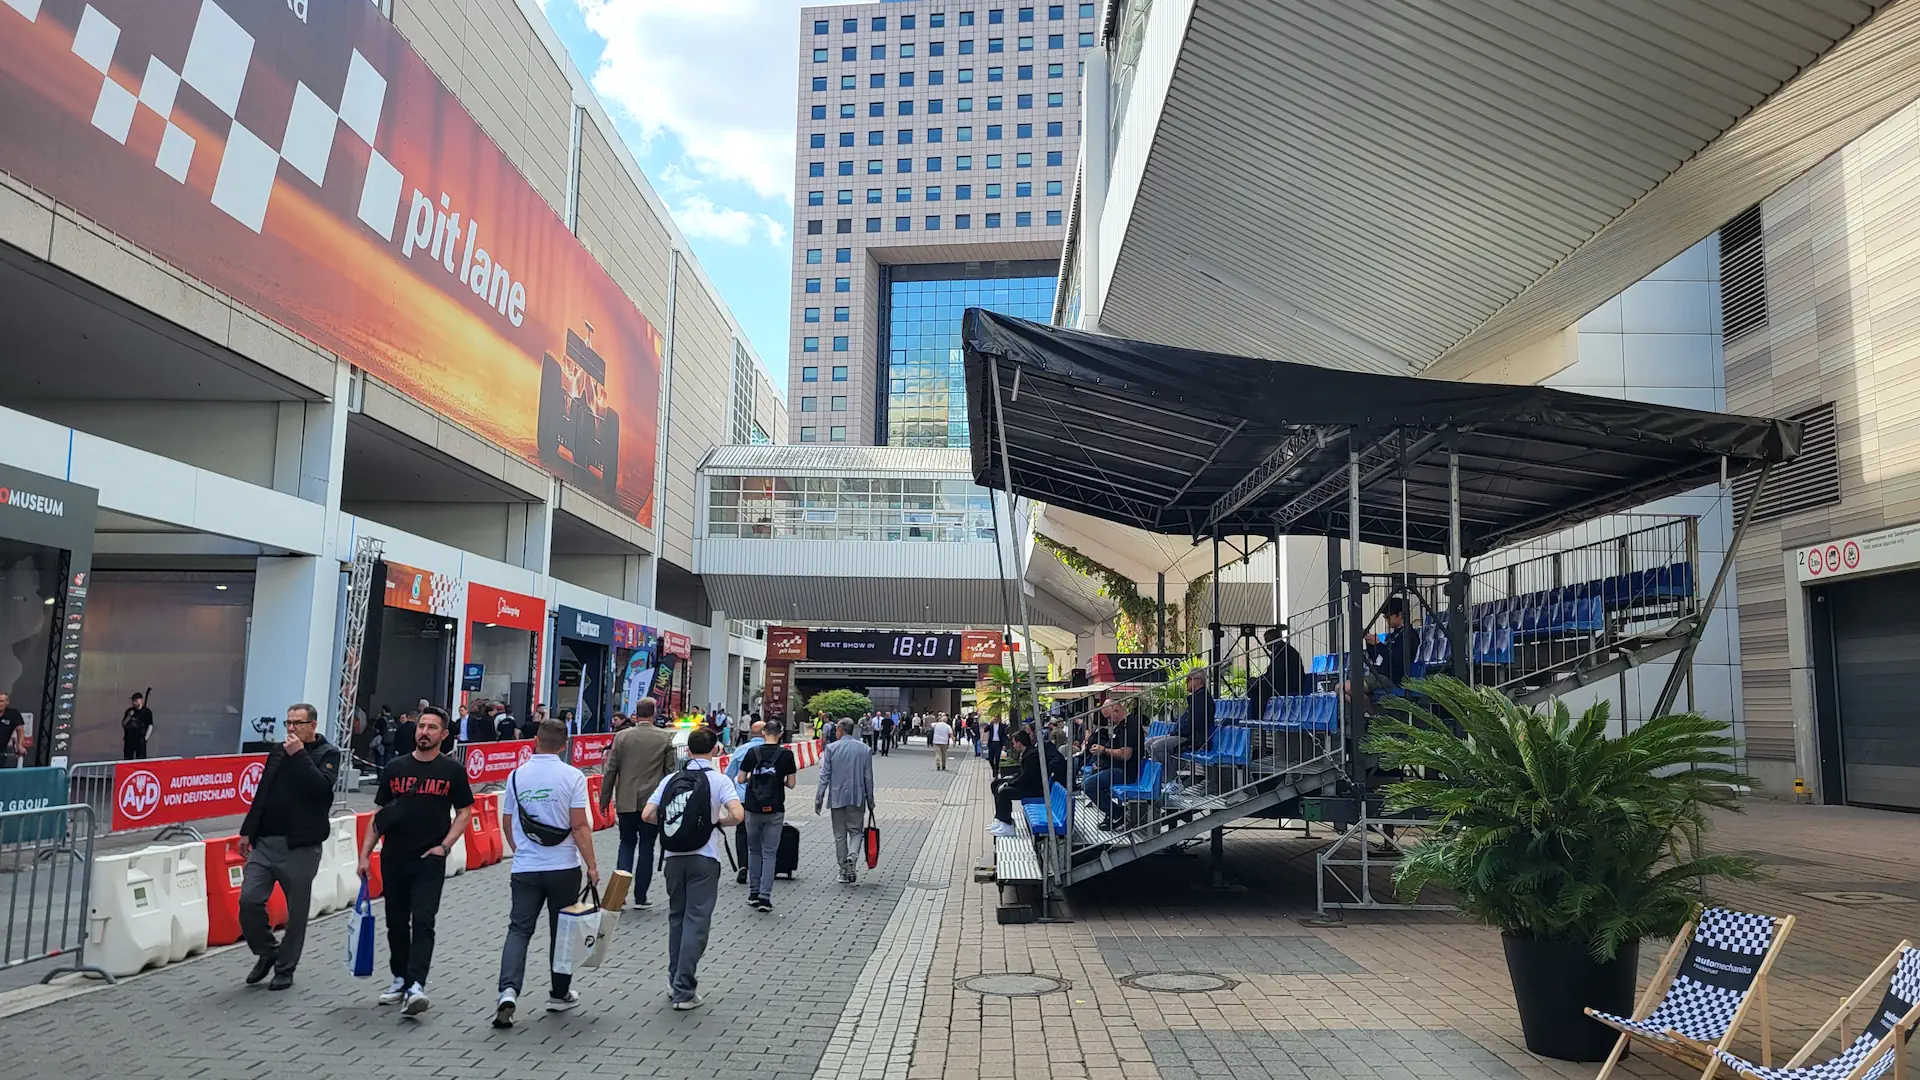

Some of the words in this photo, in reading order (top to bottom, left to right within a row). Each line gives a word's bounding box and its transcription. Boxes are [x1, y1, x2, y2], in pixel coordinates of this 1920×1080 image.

[401, 187, 461, 274] pit
[459, 218, 526, 328] lane
[1798, 551, 1805, 565] 2
[892, 636, 954, 657] 18:01
[1117, 657, 1160, 670] CHIPS
[170, 772, 233, 788] AUTOMOBILCLUB
[9, 798, 49, 812] GROUP
[163, 793, 181, 806] VON
[182, 788, 236, 804] DEUTSCHLAND
[1695, 955, 1752, 974] automechanika
